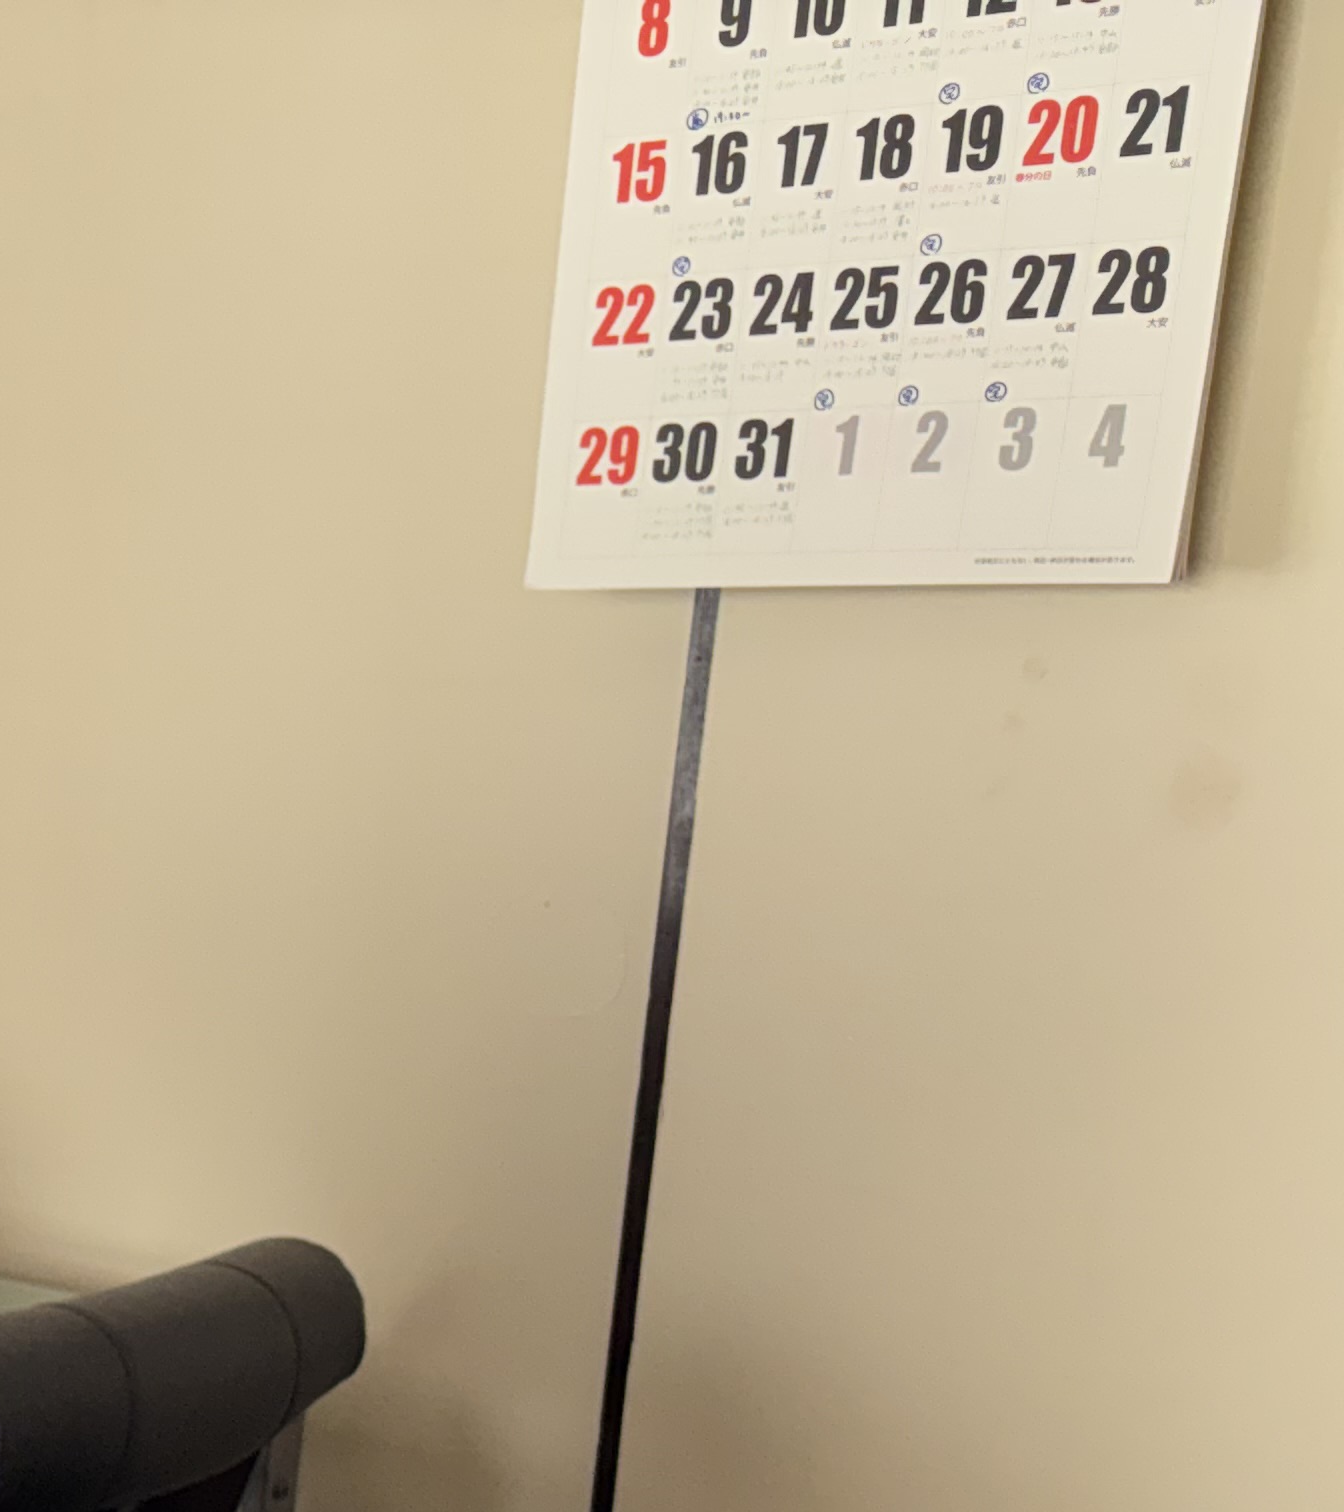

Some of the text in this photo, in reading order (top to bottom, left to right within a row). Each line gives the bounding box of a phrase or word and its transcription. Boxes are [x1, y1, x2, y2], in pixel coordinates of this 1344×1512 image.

[638, 0, 670, 57] 8
[613, 85, 1190, 203] 15 16 17 18 19 20 21
[1016, 170, 1052, 182] 春分の日
[592, 246, 1170, 346] 22 23 24 25 26 27 28
[577, 404, 1127, 485] 29 30 31 1 2 3 4
